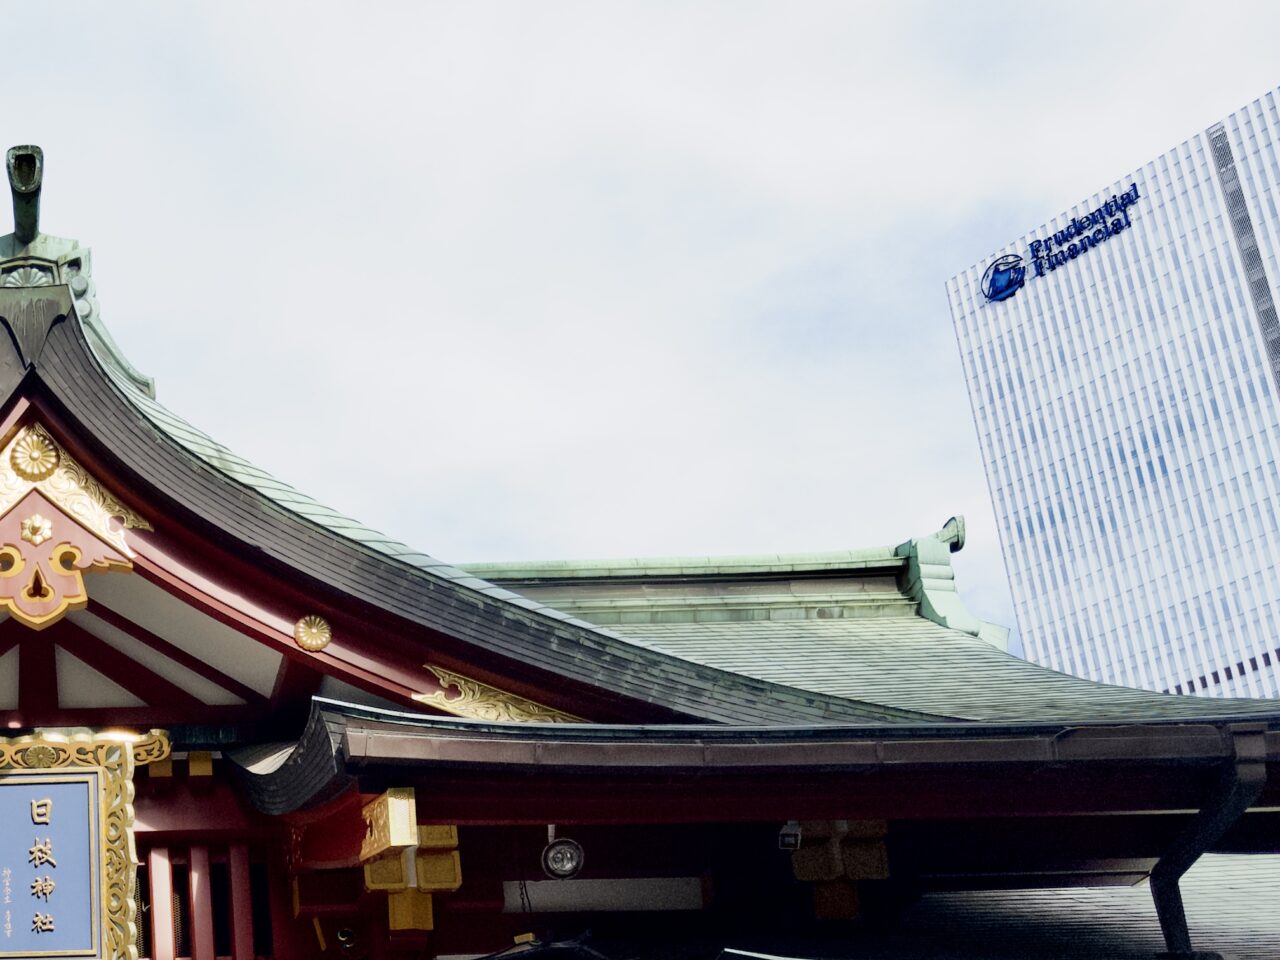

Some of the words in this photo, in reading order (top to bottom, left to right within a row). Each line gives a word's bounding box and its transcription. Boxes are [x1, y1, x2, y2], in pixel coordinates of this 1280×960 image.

[1028, 182, 1140, 259] Prudential
[1031, 210, 1132, 277] Financial
[28, 797, 57, 934] 日枝神社
